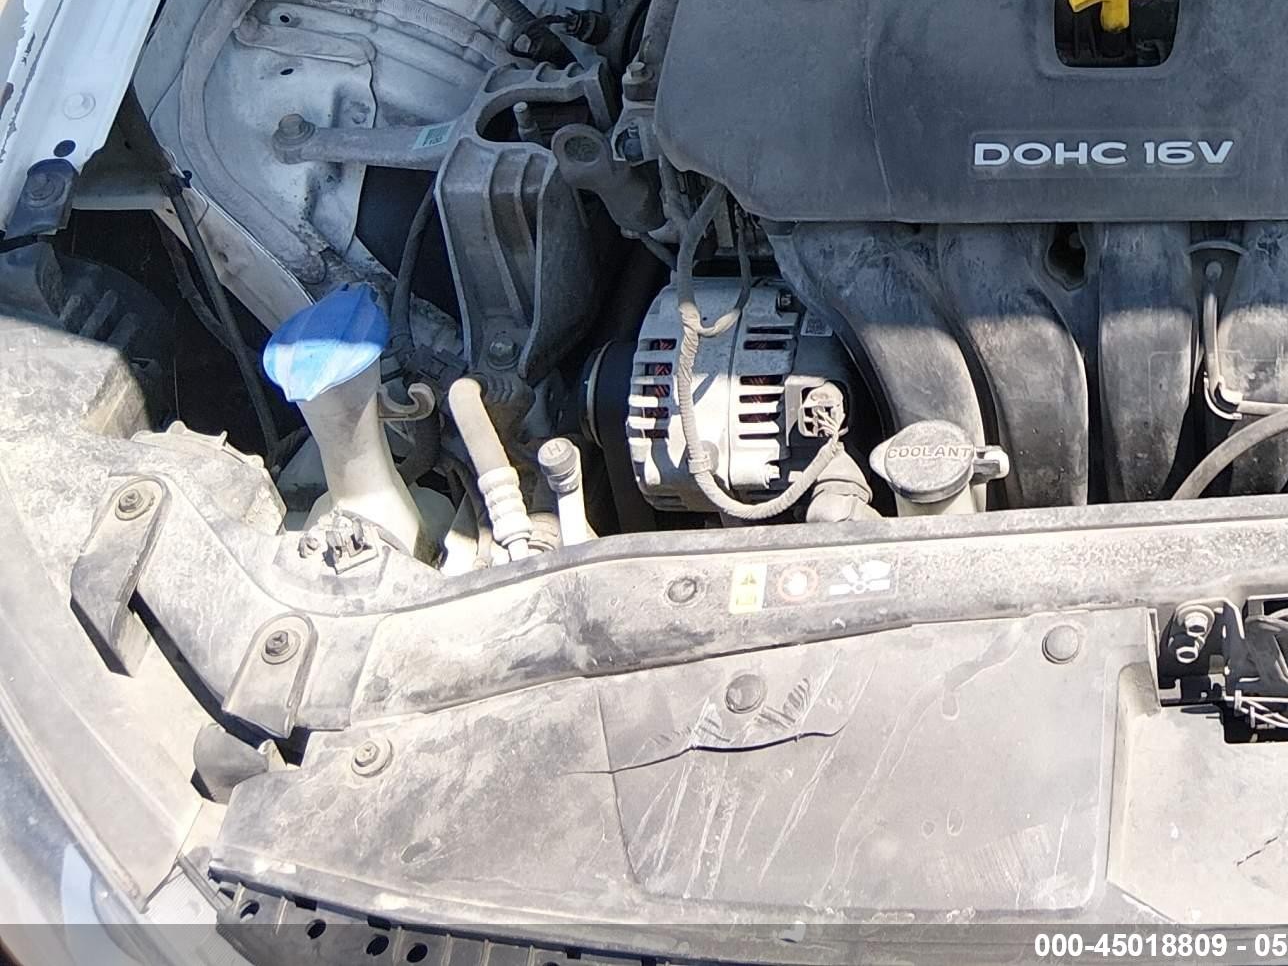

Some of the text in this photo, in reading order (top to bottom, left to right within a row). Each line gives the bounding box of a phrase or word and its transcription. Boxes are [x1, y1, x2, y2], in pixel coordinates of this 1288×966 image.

[974, 140, 1234, 166] DOHC 16V
[547, 442, 562, 456] H
[887, 445, 973, 460] COOLANT
